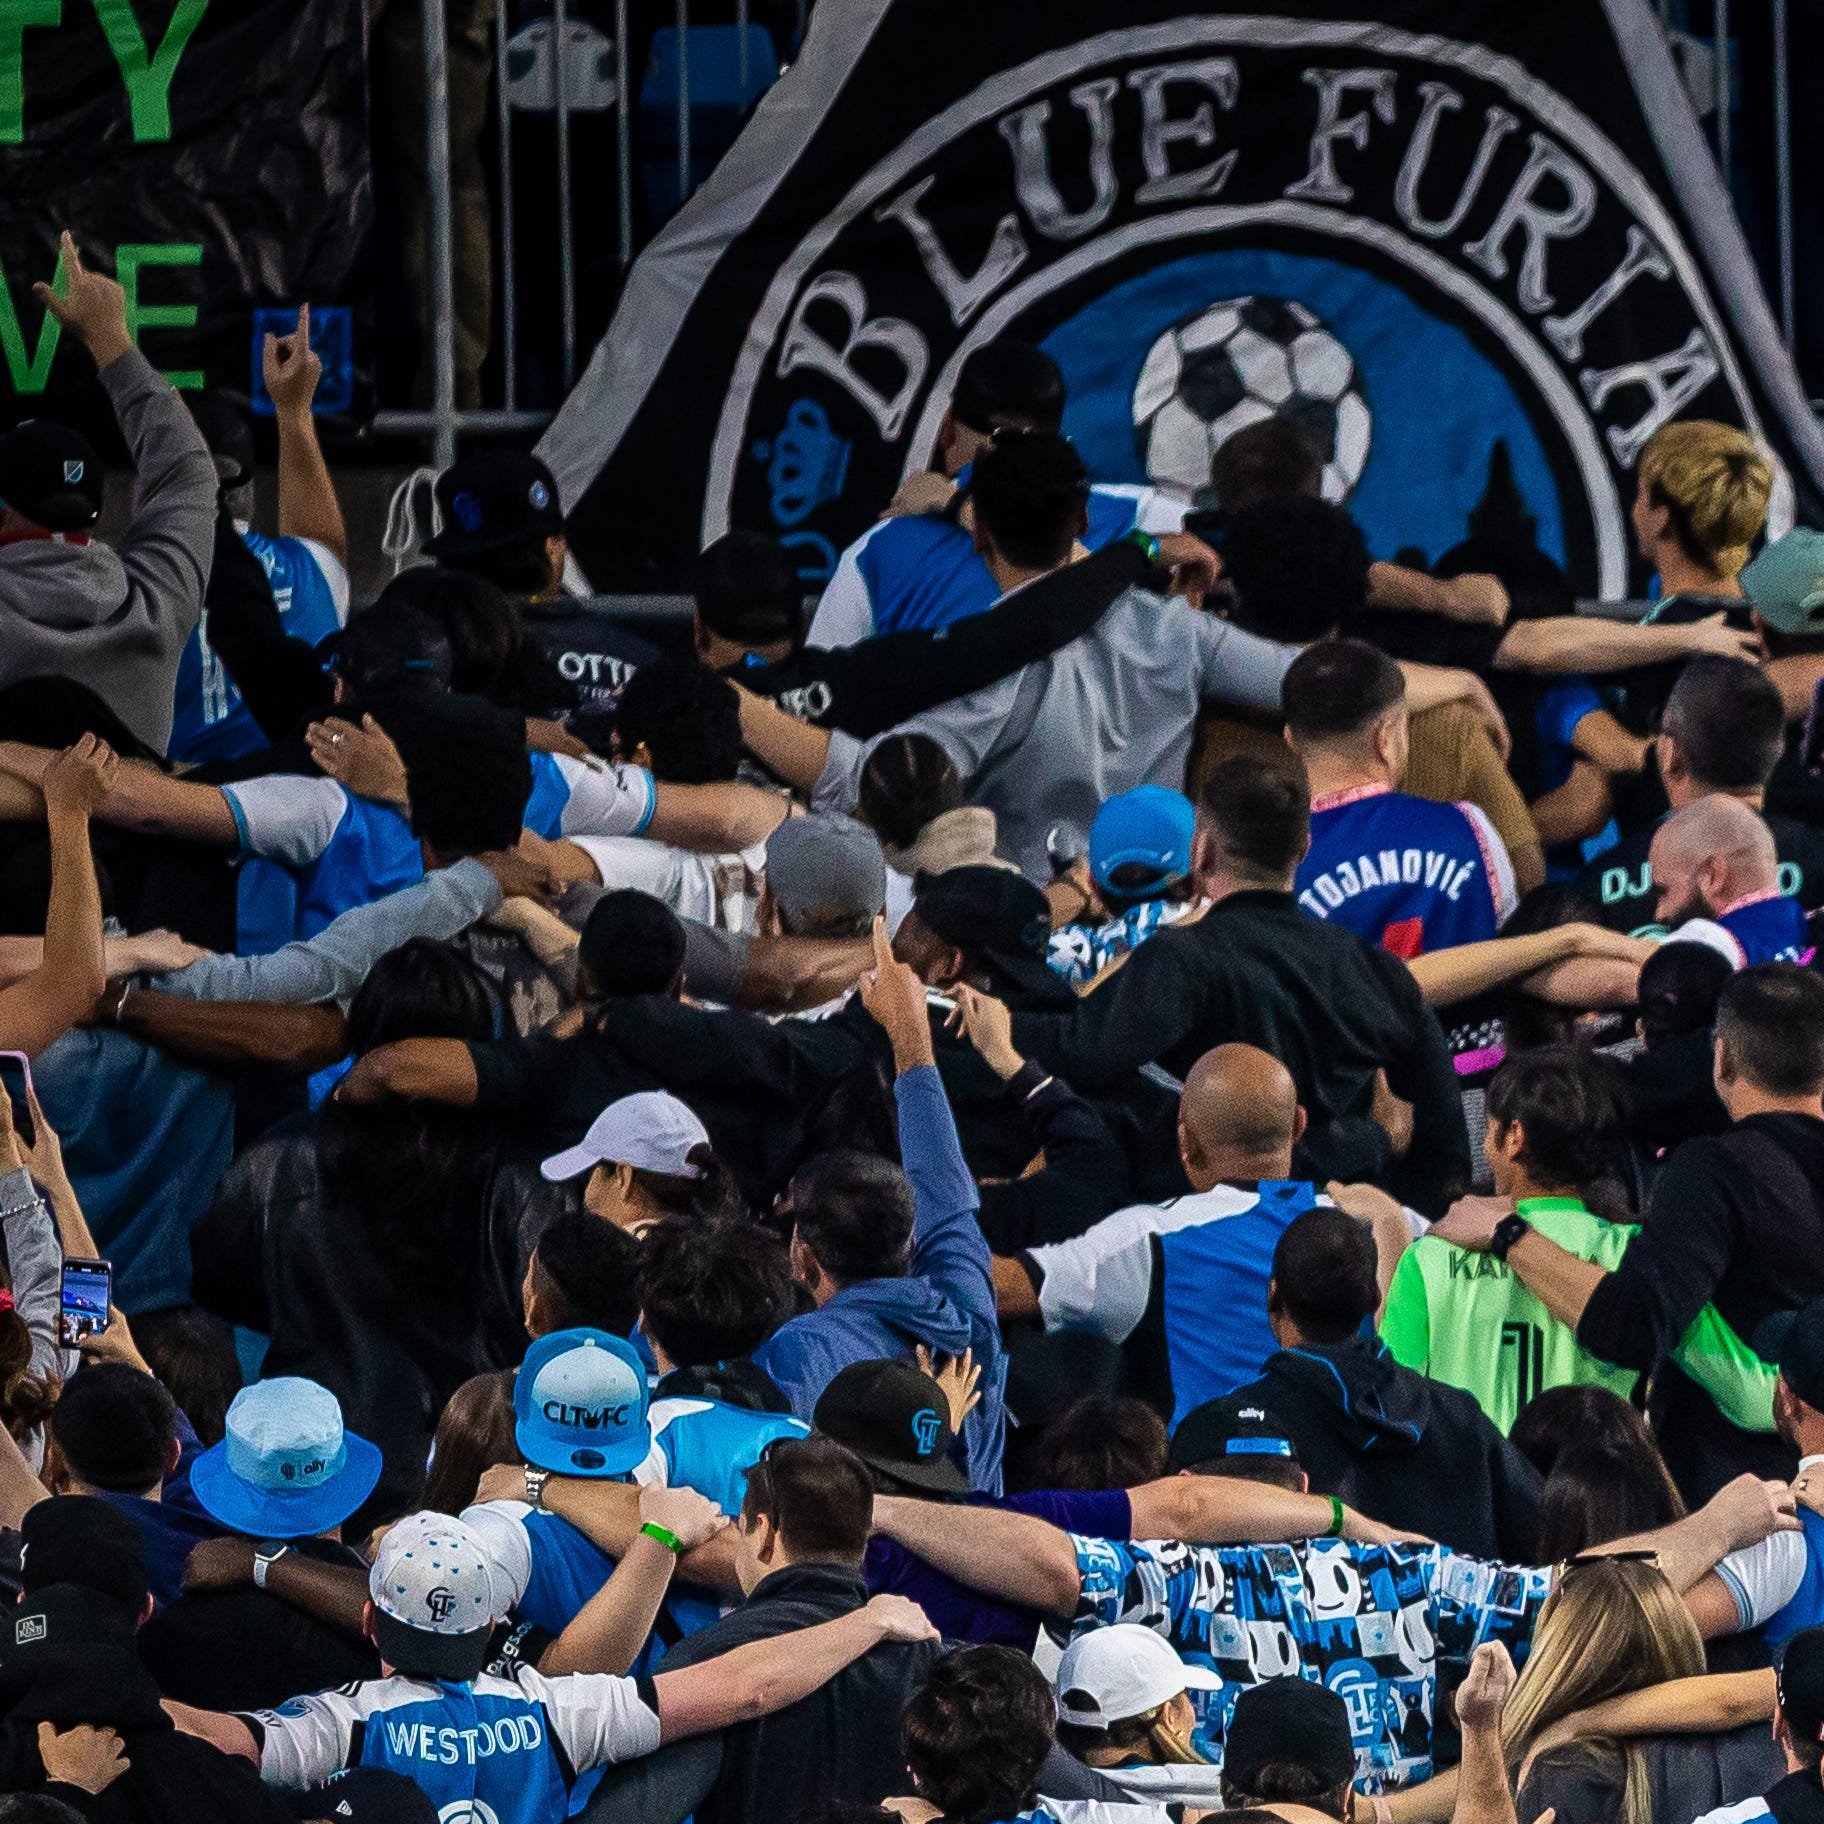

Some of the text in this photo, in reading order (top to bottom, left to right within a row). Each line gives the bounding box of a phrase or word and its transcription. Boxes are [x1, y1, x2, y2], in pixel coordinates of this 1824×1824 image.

[776, 58, 1720, 468] BLUE FURIA
[386, 1714, 542, 1766] WESTOOD
